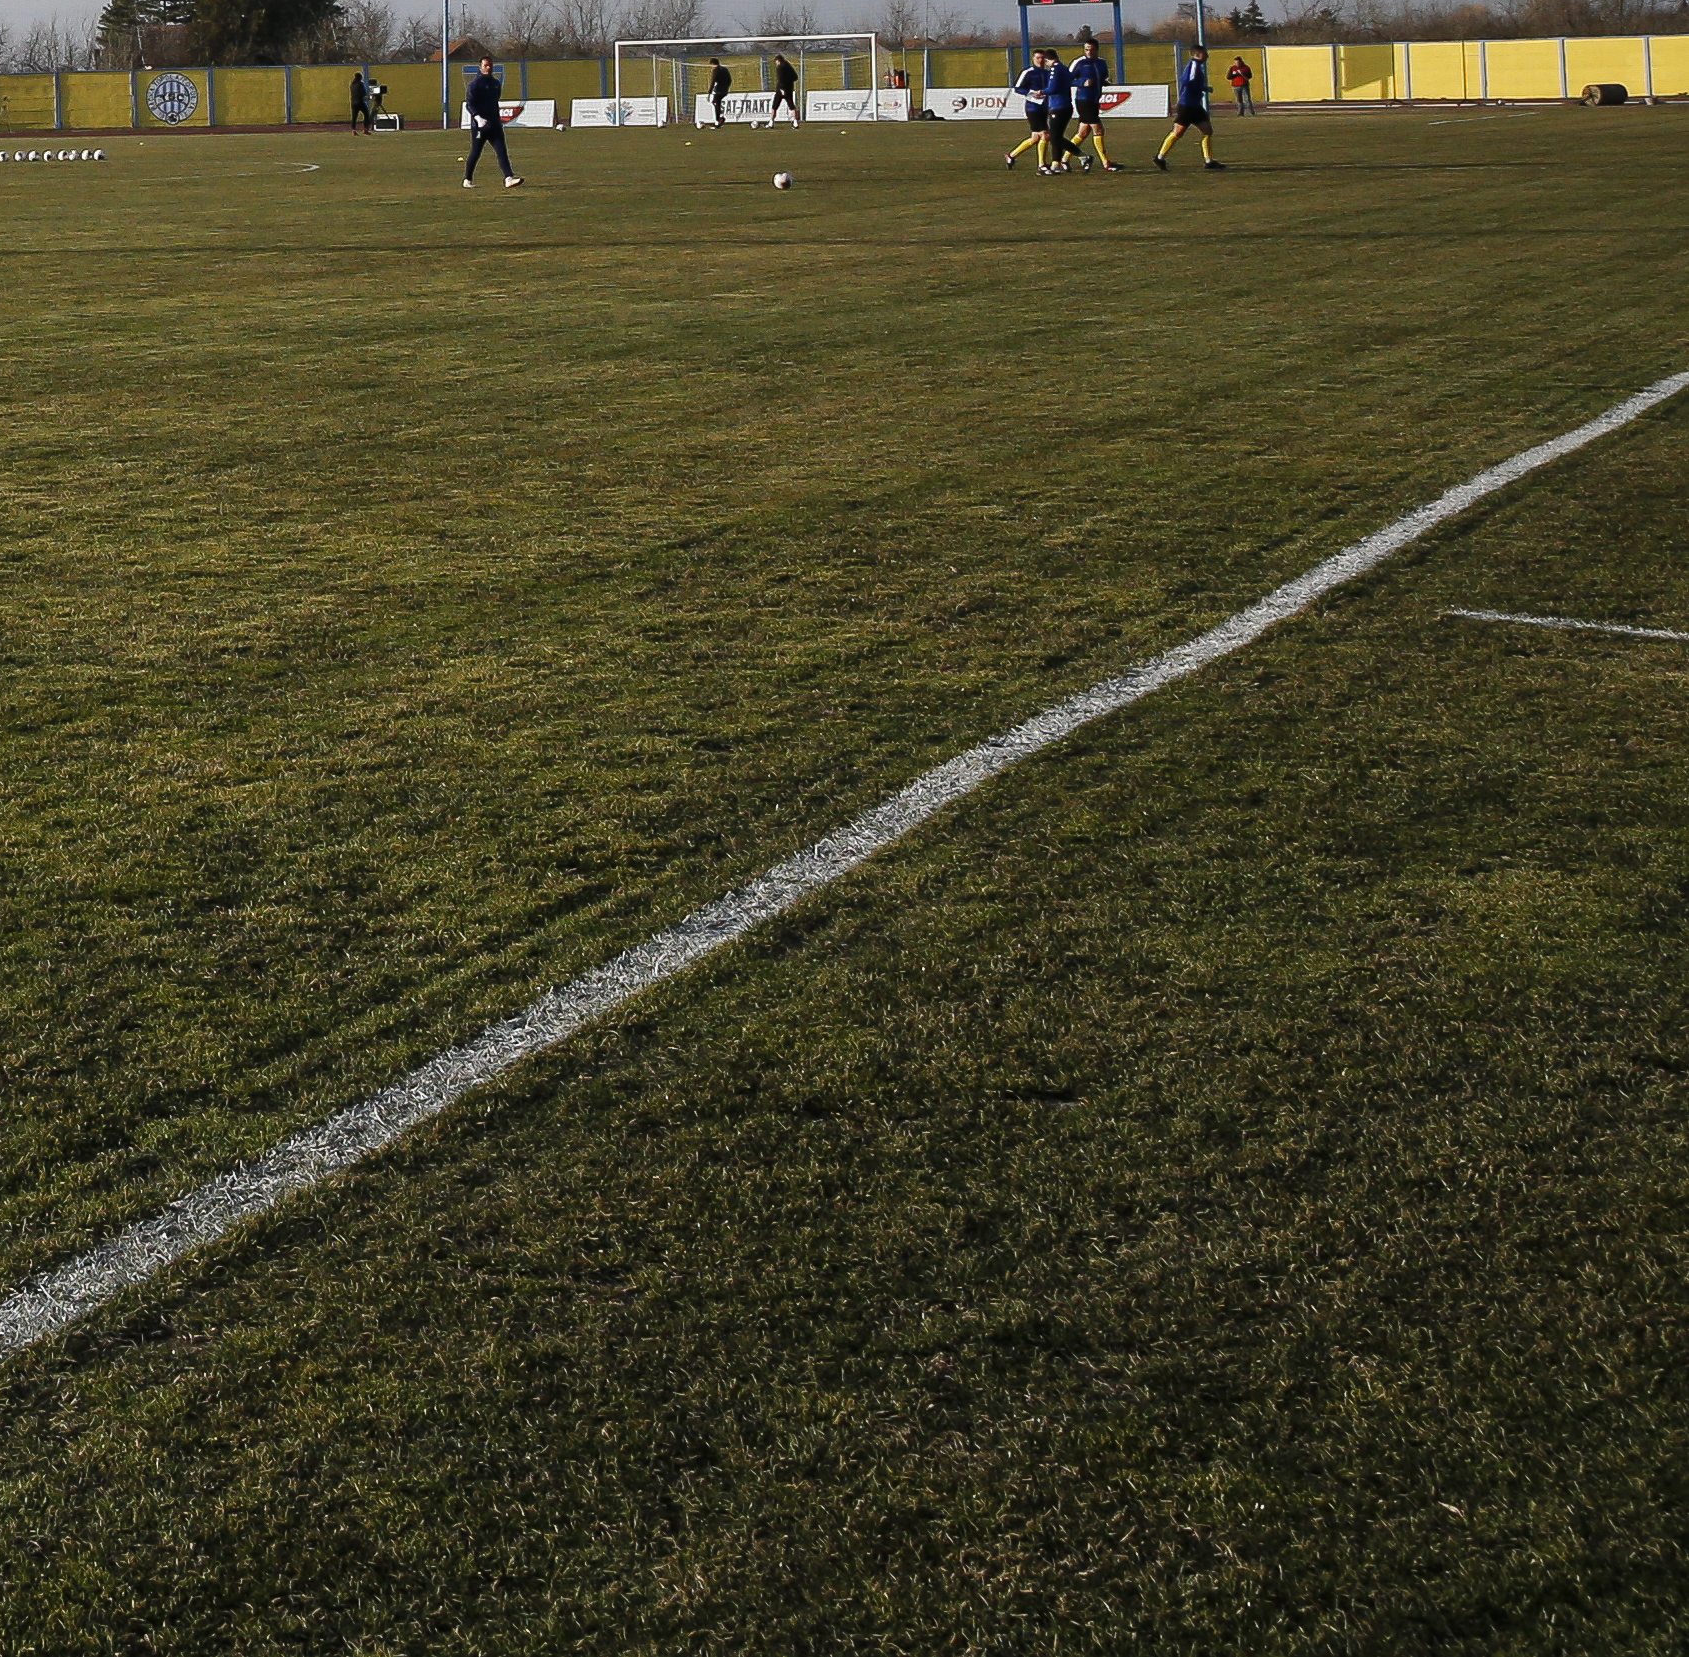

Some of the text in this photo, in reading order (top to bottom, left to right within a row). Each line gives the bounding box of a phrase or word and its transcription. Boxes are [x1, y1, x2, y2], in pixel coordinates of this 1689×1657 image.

[720, 99, 772, 114] SAT-TRAKT
[813, 102, 869, 111] ST CABLE
[971, 97, 1008, 109] IPON
